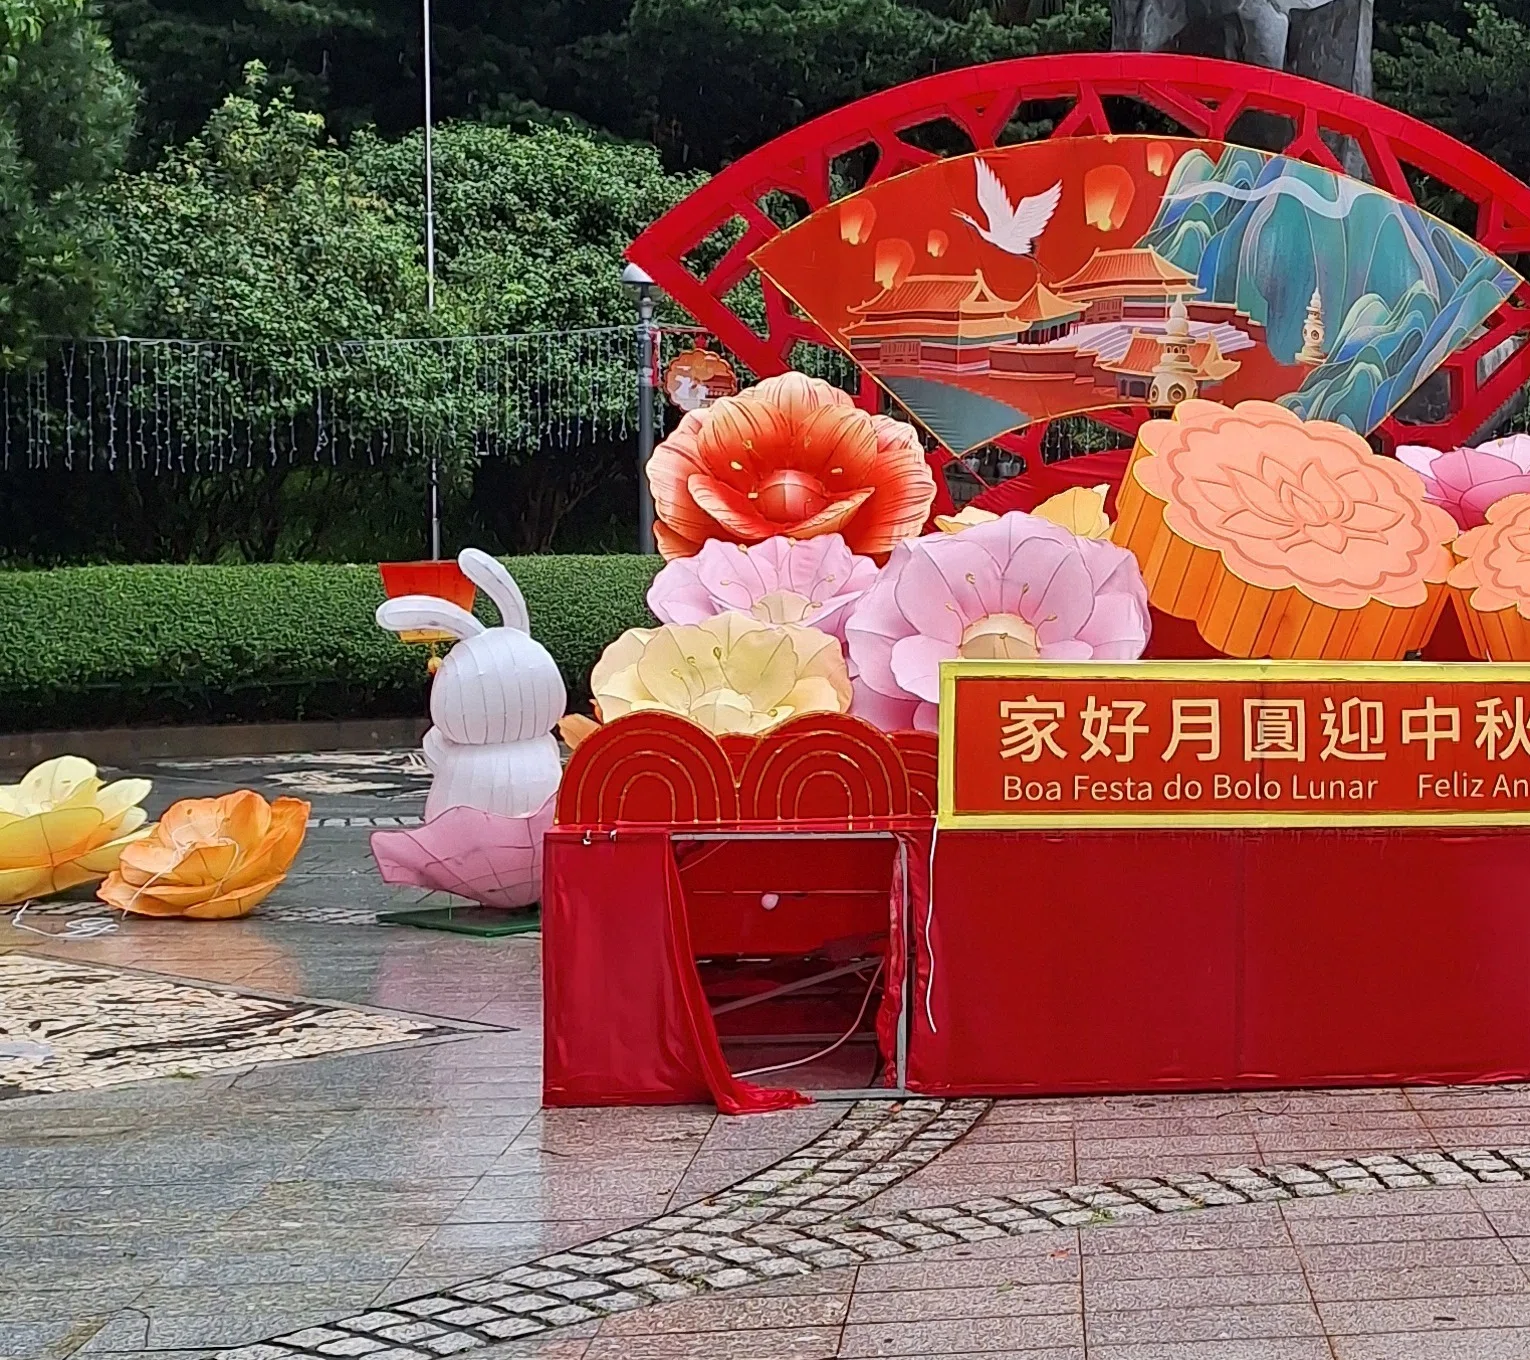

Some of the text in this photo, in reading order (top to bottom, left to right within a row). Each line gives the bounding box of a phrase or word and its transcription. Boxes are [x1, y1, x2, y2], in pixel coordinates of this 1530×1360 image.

[1004, 775, 1062, 801] Boa
[1074, 775, 1152, 801] Festa
[1163, 773, 1203, 800] do
[1213, 772, 1281, 800] Bolo
[1292, 774, 1379, 800] Lunar
[1418, 771, 1484, 799] Feliz
